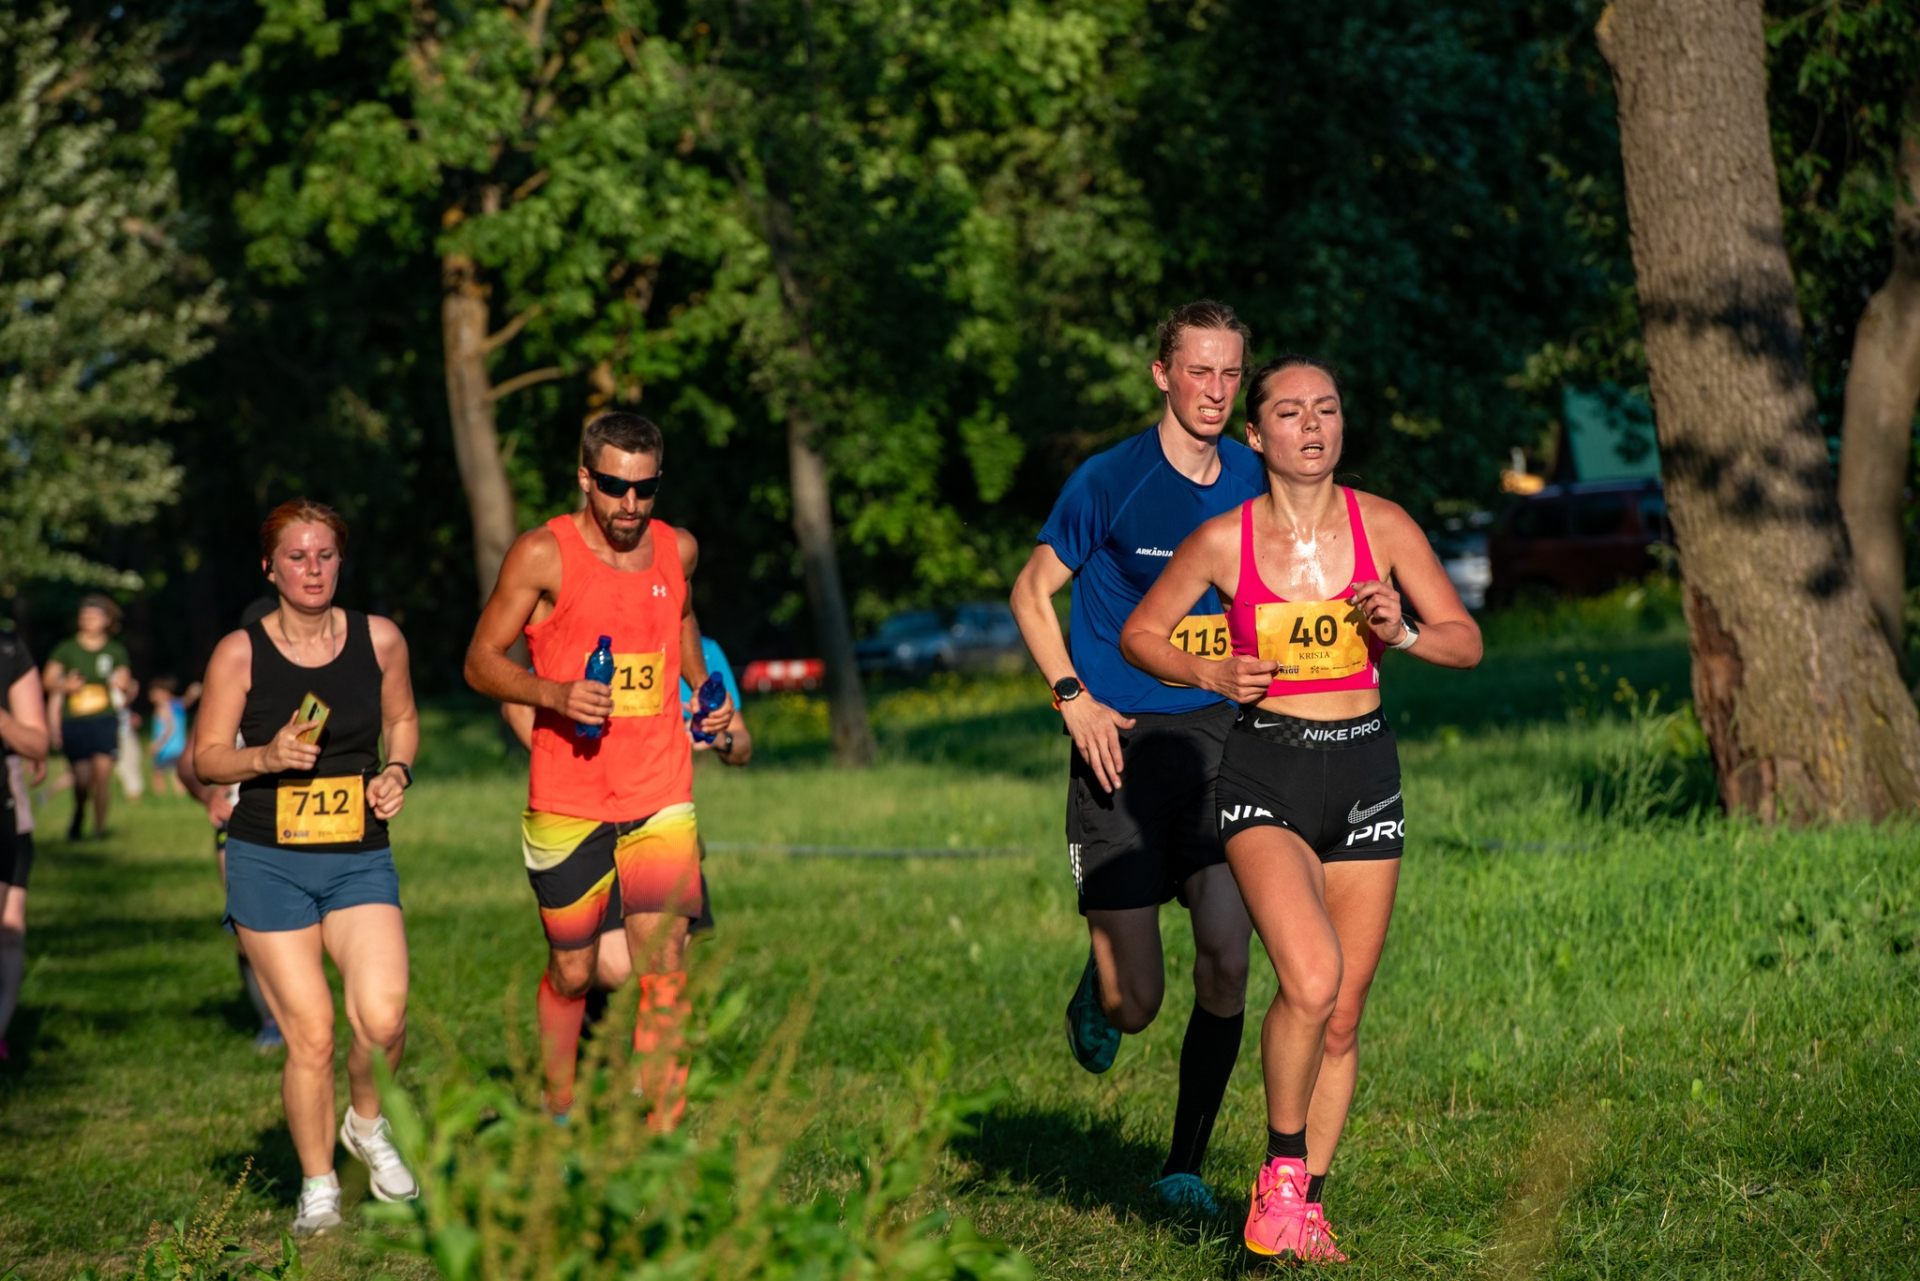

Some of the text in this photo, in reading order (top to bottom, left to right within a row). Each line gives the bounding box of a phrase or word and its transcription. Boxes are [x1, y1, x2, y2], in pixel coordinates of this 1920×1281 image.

[1176, 627, 1227, 656] 115
[1289, 614, 1338, 648] 40
[1299, 652, 1330, 660] KRISTA
[613, 665, 654, 690] 13
[1303, 719, 1381, 741] NIKE PRO
[292, 790, 349, 816] 712
[1221, 805, 1288, 830] NIK
